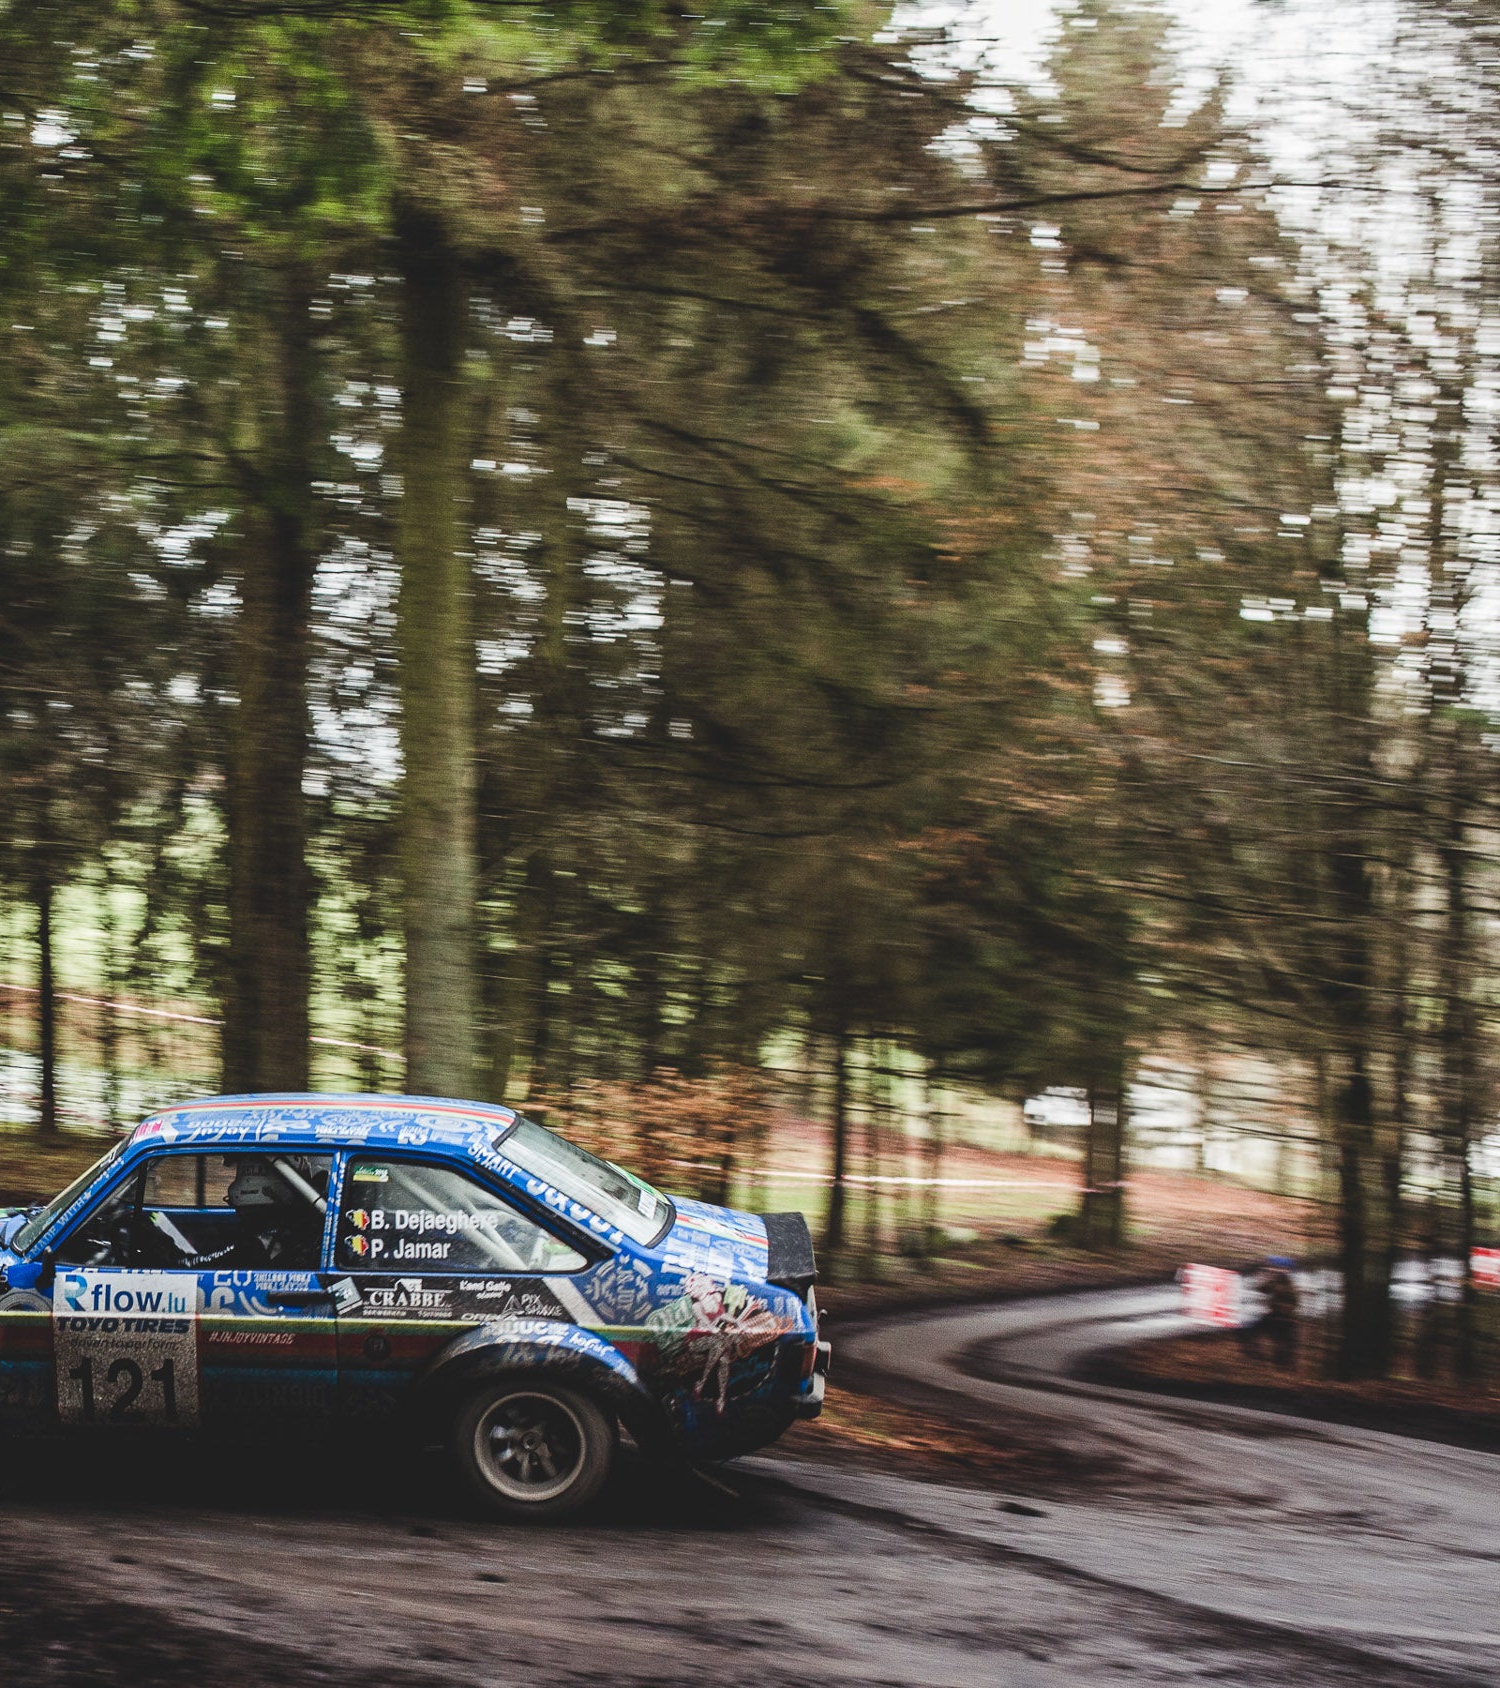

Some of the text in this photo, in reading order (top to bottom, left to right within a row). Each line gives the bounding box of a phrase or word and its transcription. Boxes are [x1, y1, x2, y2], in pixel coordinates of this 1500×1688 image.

[467, 1144, 522, 1179] SMART
[371, 1209, 498, 1235] B. Dejaeghere
[370, 1238, 451, 1259] P. Jamar
[369, 1291, 446, 1308] CRABBE
[57, 1318, 190, 1334] TOYO TIRES
[69, 1357, 177, 1421] 121
